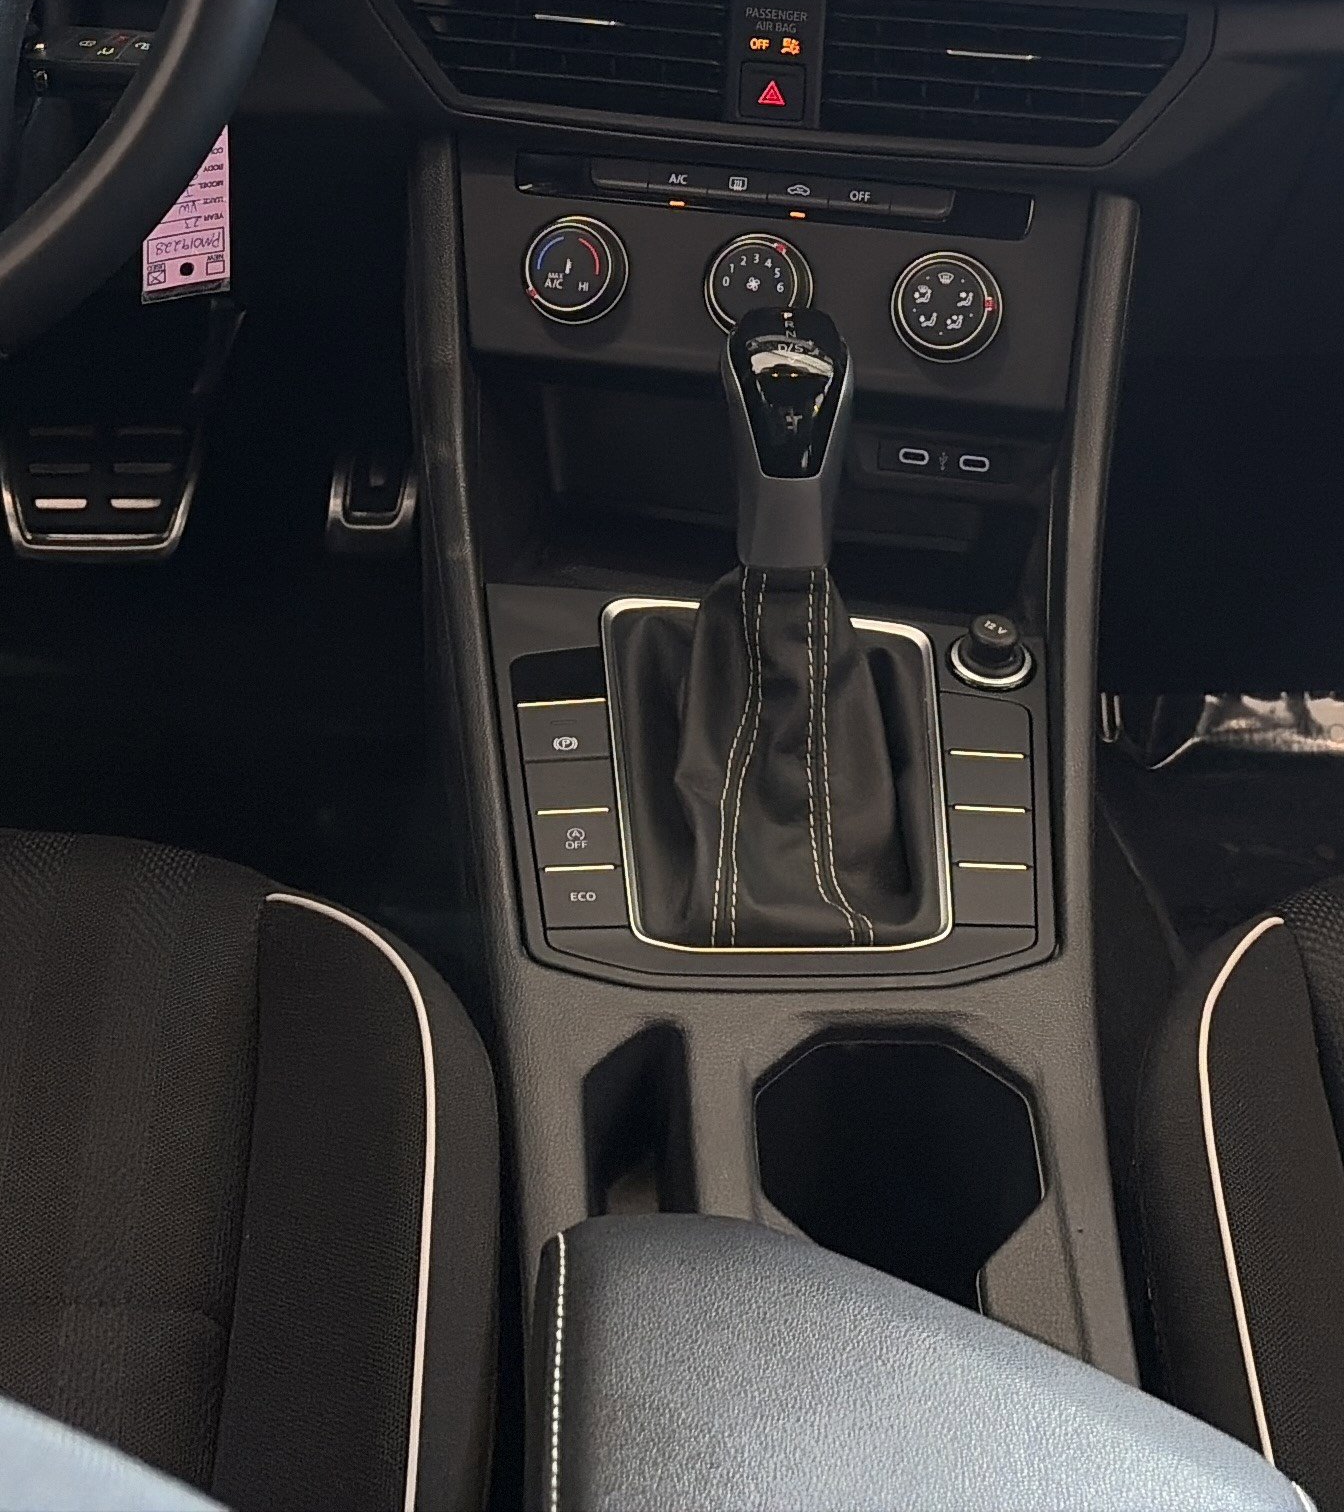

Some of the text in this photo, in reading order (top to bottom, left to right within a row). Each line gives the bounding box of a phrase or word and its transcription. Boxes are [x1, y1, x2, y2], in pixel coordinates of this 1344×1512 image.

[745, 6, 808, 22] PASSENGER
[756, 20, 797, 34] AIR BAG
[749, 37, 770, 50] OFF
[669, 173, 688, 185] A/C
[849, 190, 871, 203] OFF
[203, 213, 224, 222] YEAR
[740, 256, 747, 266] 2
[754, 253, 760, 264] 3
[764, 258, 773, 269] 4
[729, 263, 735, 274] 1
[774, 267, 781, 278] 5
[544, 278, 564, 290] A/C
[578, 281, 590, 292] HI
[722, 275, 730, 287] 0
[776, 281, 785, 293] 6
[784, 320, 795, 329] R
[565, 840, 588, 850] OFF
[570, 891, 597, 902] ECO
